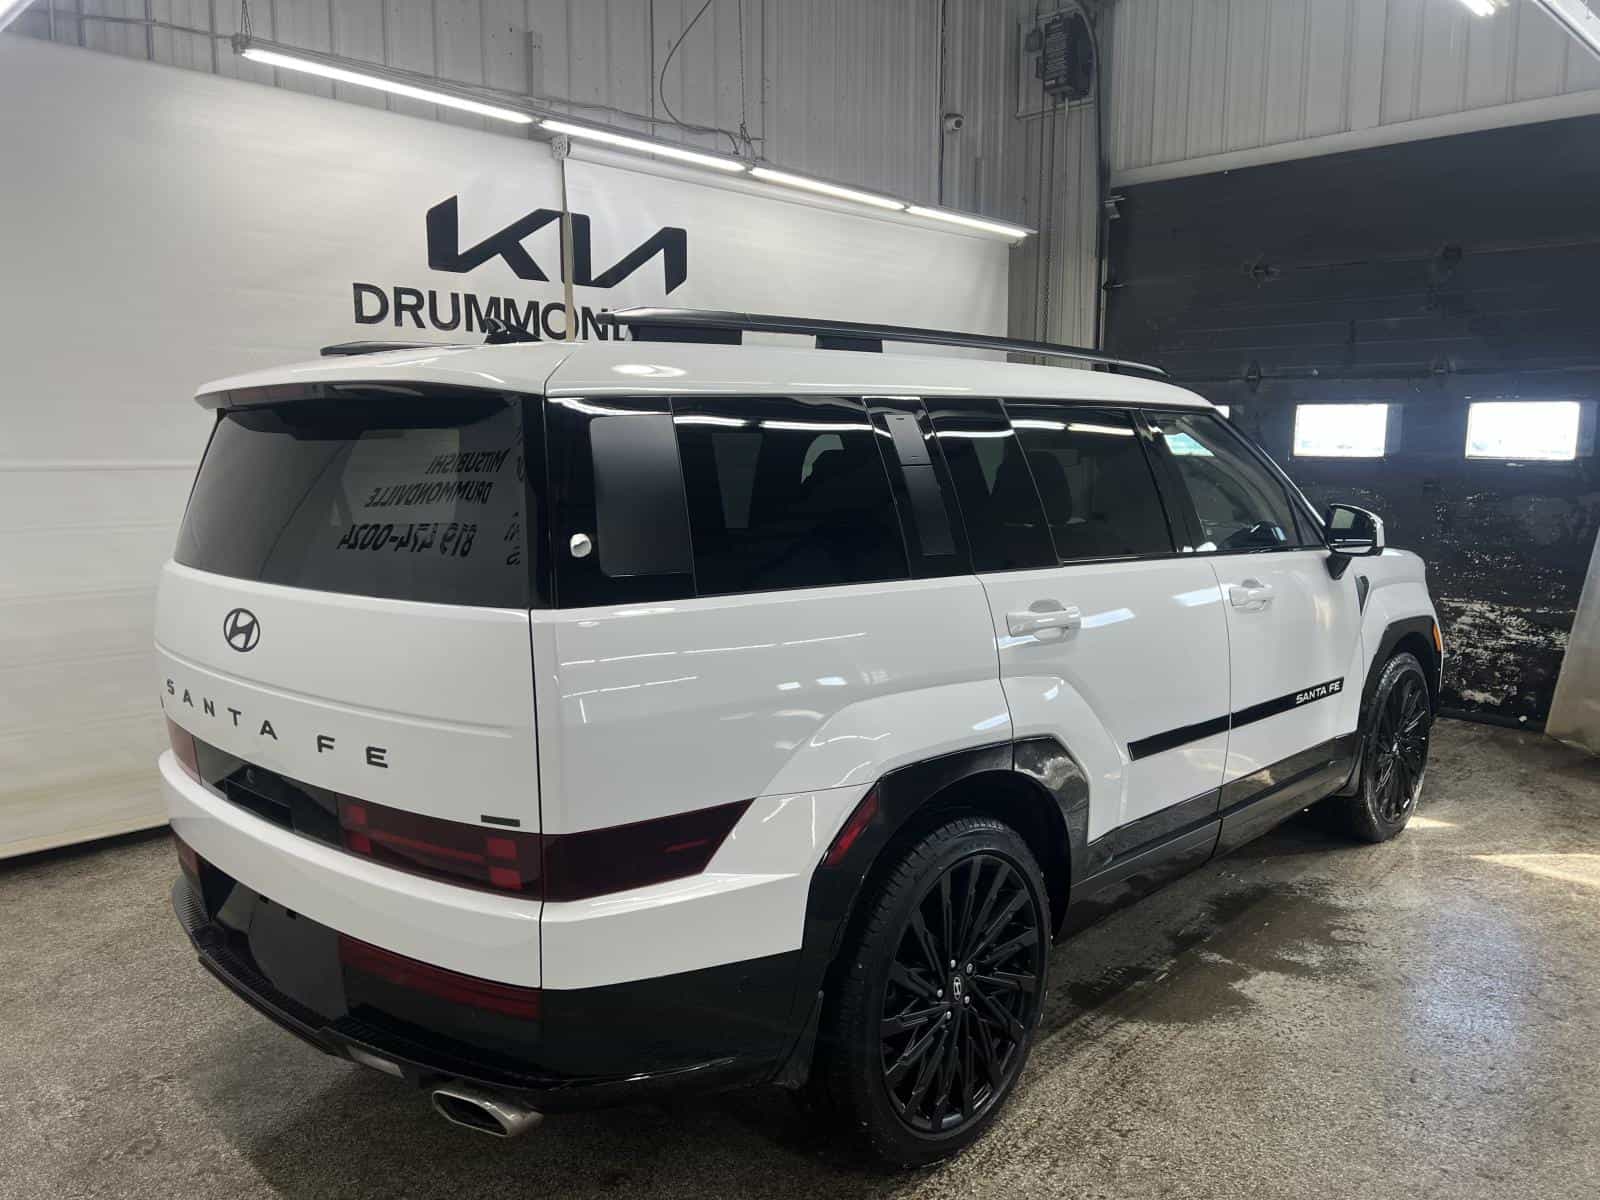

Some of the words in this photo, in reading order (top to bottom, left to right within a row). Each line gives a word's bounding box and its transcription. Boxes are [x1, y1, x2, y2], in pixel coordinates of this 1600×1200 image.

[1295, 685, 1327, 704] SANTA
[1328, 681, 1341, 693] FE
[166, 678, 278, 740] SANTA
[317, 734, 389, 768] FE
